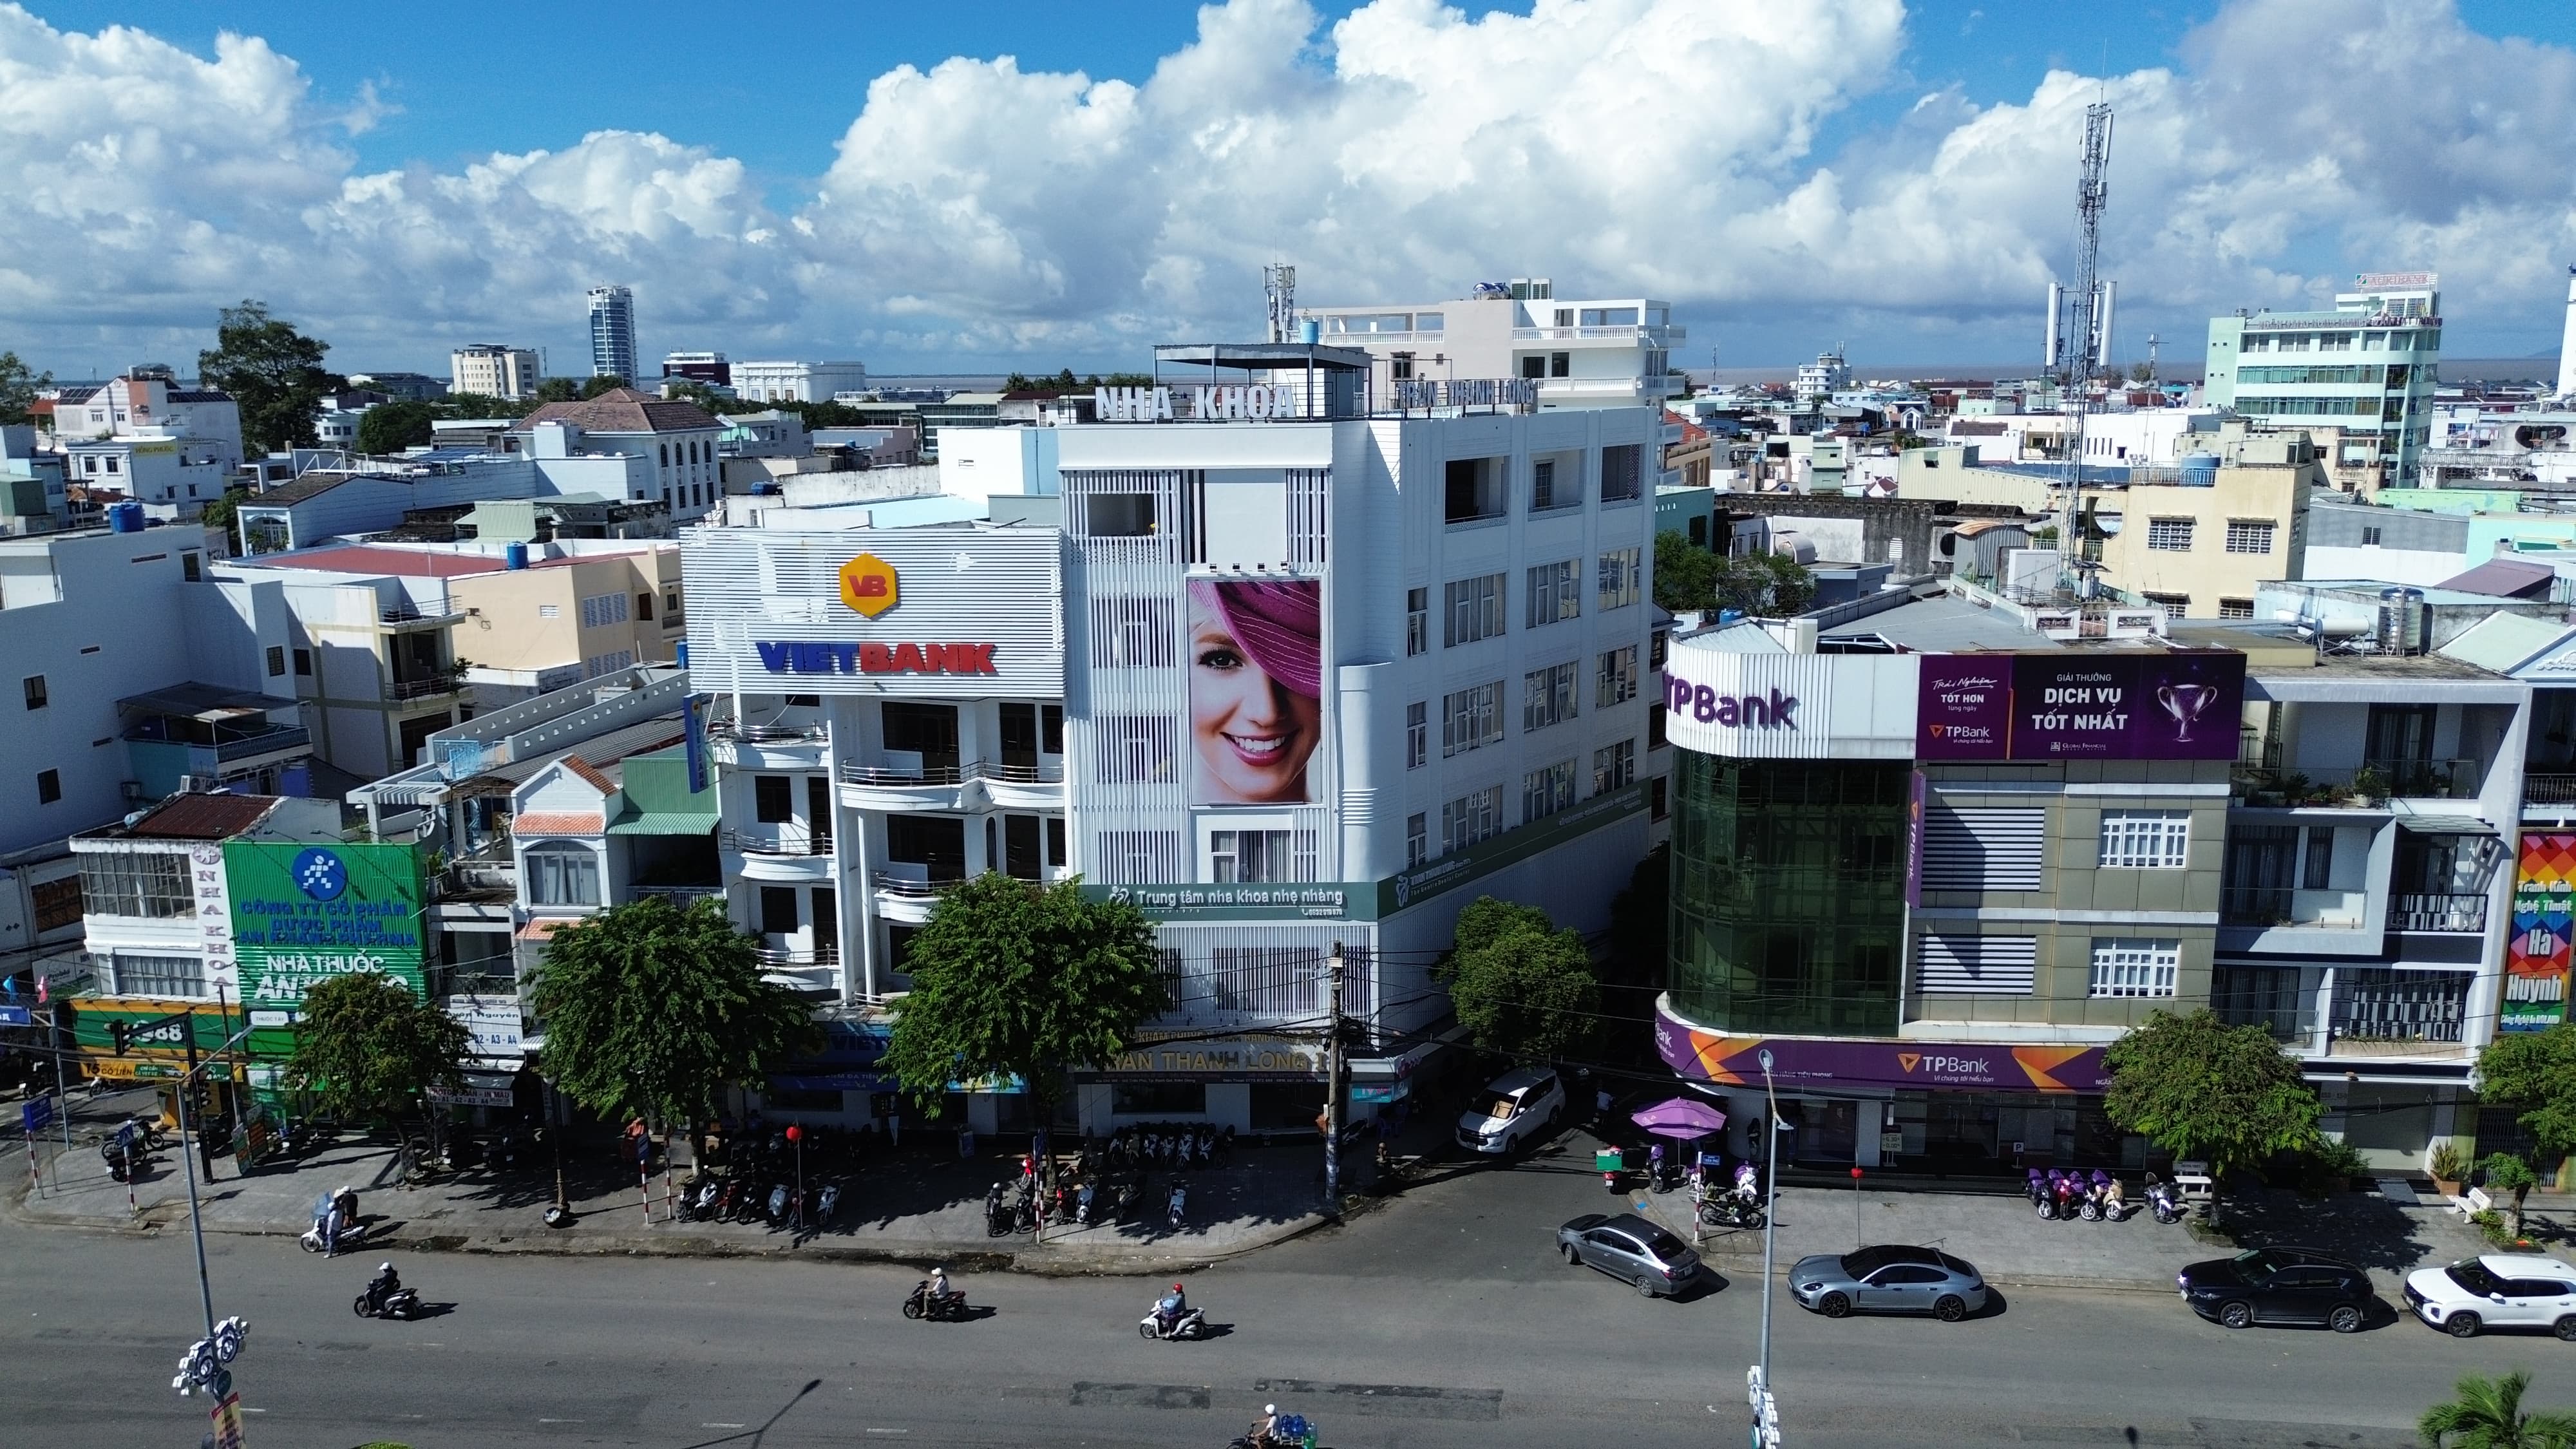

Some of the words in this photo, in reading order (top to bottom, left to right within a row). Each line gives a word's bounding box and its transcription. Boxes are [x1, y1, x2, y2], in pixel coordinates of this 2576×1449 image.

[1447, 379, 1495, 406] THANH
[1499, 377, 1534, 405] LONG
[1095, 386, 1173, 419] NHA
[1195, 386, 1296, 418] KHOA
[848, 575, 887, 598] VB
[756, 642, 996, 672] VIETBANK
[2057, 672, 2073, 681] GIẢI
[2076, 672, 2112, 682] THƯỞNG
[1663, 674, 1801, 732] TPBank
[1941, 692, 1960, 703] TỐT
[1962, 694, 1984, 703] HƠN
[2044, 688, 2090, 707] DỊCH
[2096, 688, 2121, 707] VỤ
[2032, 708, 2069, 730] TỐT
[2074, 708, 2128, 730] NHẤT
[1946, 726, 1990, 737] TPBank
[1908, 822, 1917, 882] TPBank
[2518, 881, 2546, 893] Tranh
[2549, 880, 2572, 893] Kính
[241, 900, 293, 914] CÔNG
[298, 902, 323, 914] TY
[1137, 891, 1177, 907] Trung
[1180, 891, 1204, 904] tâm
[1209, 891, 1233, 903] nha
[1237, 889, 1269, 903] khoa
[1273, 889, 1298, 905] nhẹ
[1302, 888, 1343, 905] nhàng
[2514, 900, 2539, 913] Nghệ
[2543, 900, 2572, 914] Thuật
[2528, 929, 2552, 955] Hà
[267, 952, 311, 972] NHÀ
[312, 948, 385, 973] THUỐC
[254, 975, 300, 999] AN
[2506, 973, 2562, 1003] Huỳnh
[491, 1034, 500, 1045] A3
[507, 1034, 517, 1045] A4
[86, 1063, 100, 1075] 15
[1161, 1052, 1239, 1071] THANH
[1246, 1051, 1308, 1072] LONG
[1923, 1056, 1989, 1073] TPBank
